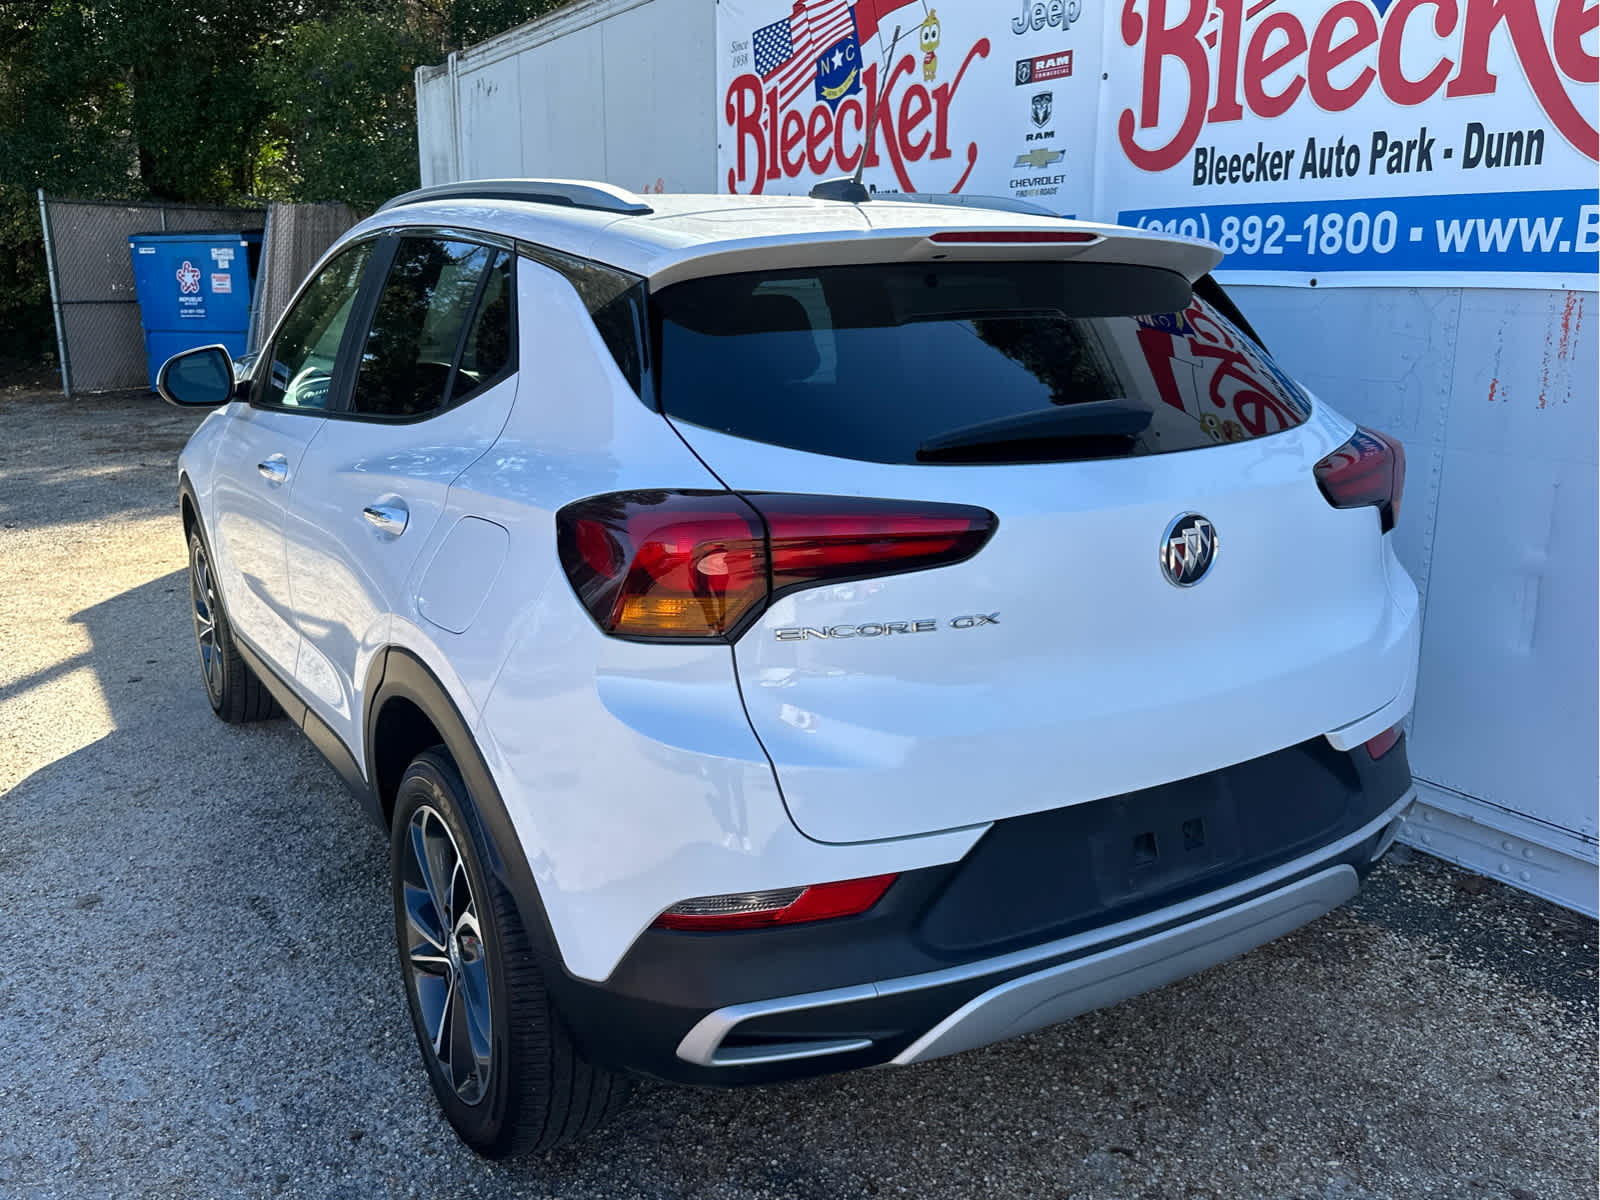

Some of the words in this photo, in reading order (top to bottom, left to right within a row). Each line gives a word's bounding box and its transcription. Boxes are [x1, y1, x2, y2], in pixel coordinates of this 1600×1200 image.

[1011, 0, 1081, 35] Jeep
[1035, 56, 1069, 70] RAM
[1026, 131, 1055, 142] RAM
[1193, 141, 1295, 186] Bleecker
[1299, 136, 1360, 179] Auto
[1369, 127, 1435, 175] Park
[1462, 122, 1545, 169] Dunn
[1009, 175, 1066, 188] CHEVROLET
[1219, 210, 1398, 255] 892-1800
[776, 618, 937, 641] ENCORE
[950, 611, 1001, 629] GX
